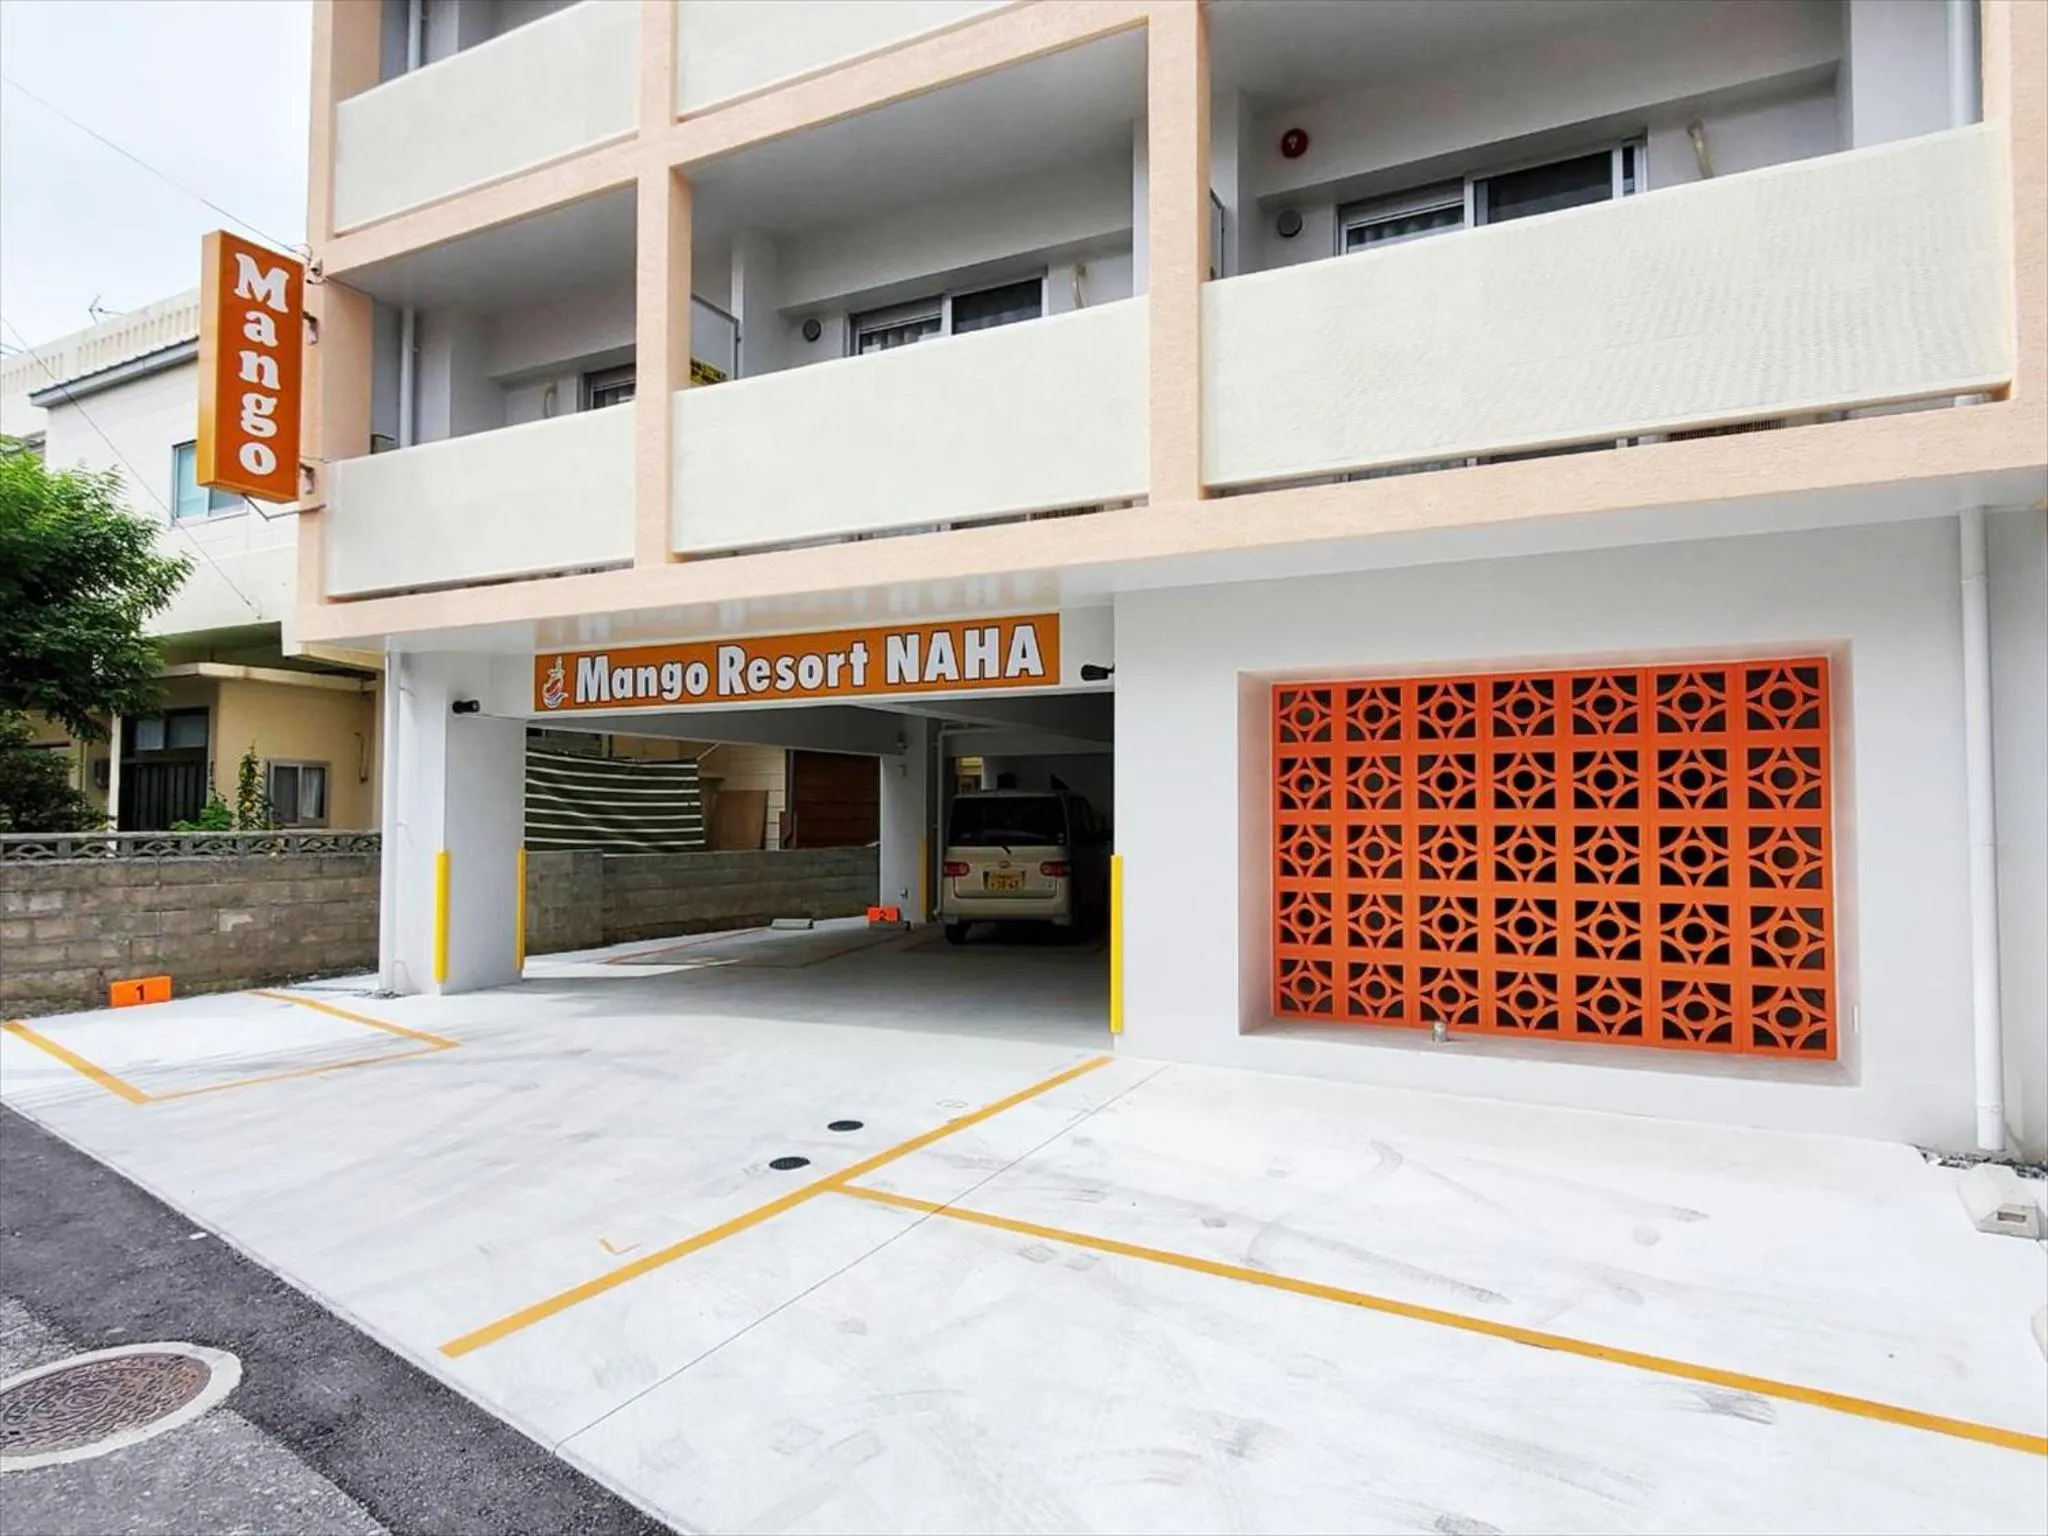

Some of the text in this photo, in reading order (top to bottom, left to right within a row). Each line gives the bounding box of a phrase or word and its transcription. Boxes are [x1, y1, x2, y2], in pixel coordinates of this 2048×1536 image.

[234, 252, 290, 476] Mango
[575, 624, 1045, 703] Mango Resort NAHA
[136, 984, 145, 1001] 1
